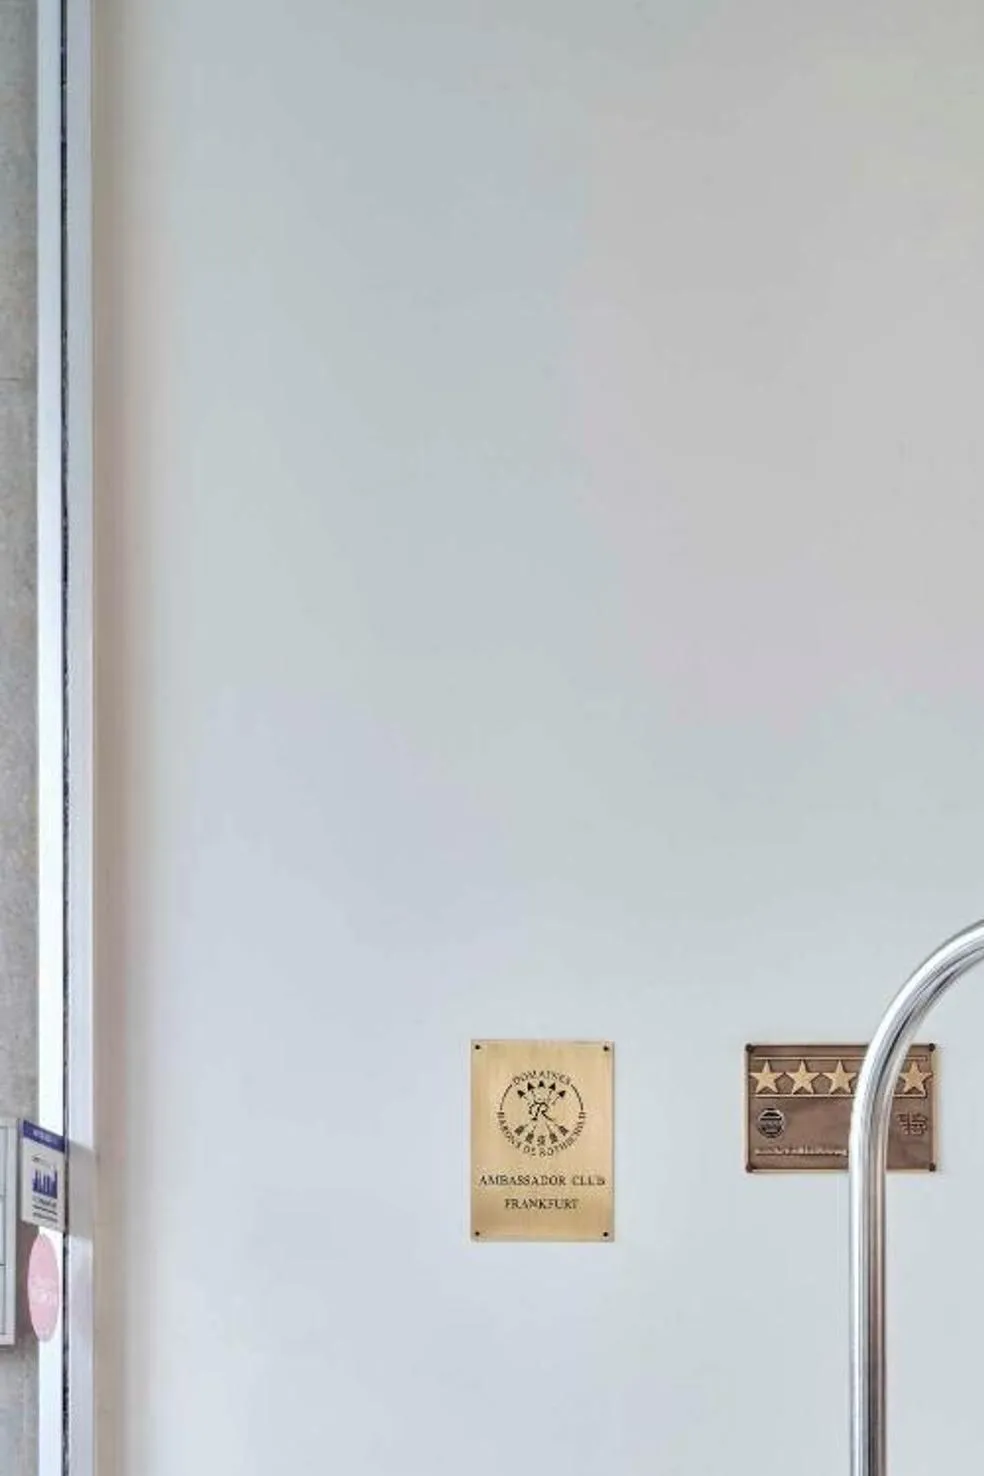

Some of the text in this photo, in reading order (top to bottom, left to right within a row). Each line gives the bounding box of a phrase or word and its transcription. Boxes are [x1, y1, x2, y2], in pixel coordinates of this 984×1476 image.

[479, 1174, 606, 1187] AMBASSADOR CLUB
[503, 1198, 580, 1210] FRANKFURT
